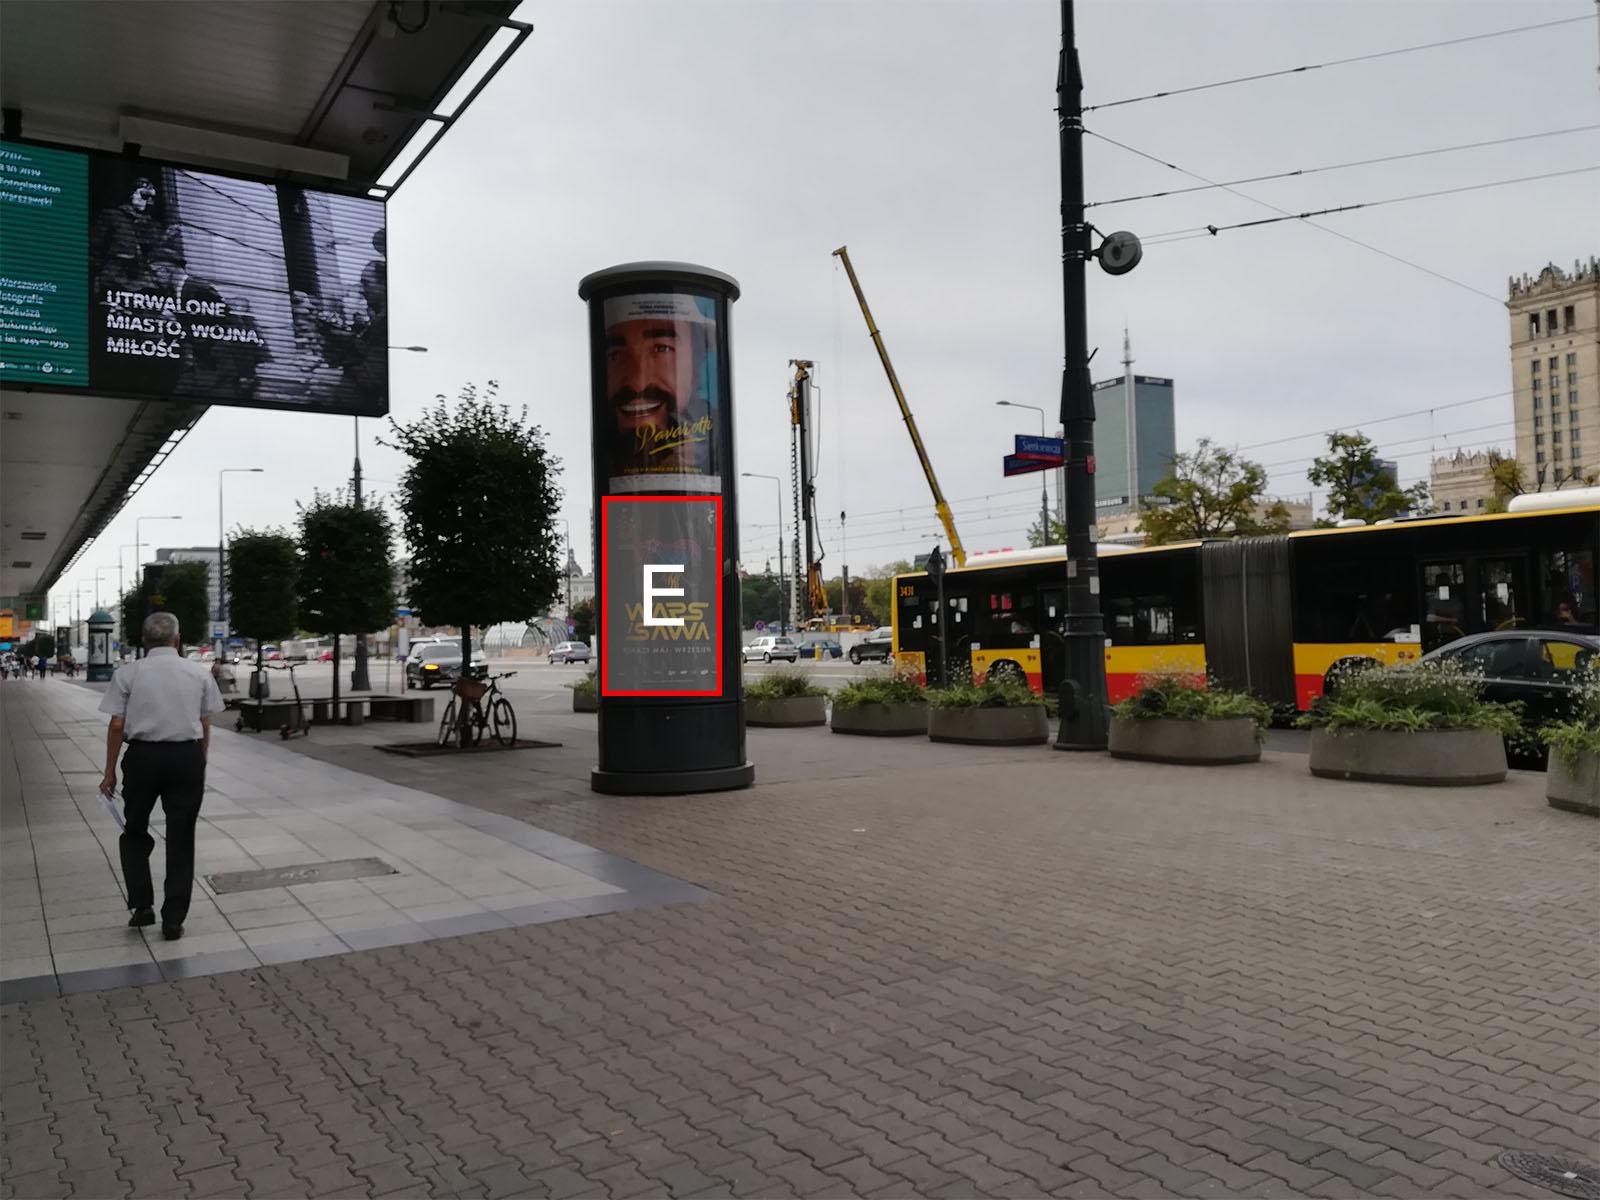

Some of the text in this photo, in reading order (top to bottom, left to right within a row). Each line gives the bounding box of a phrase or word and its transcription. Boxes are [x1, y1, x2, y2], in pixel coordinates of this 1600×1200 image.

[106, 290, 227, 317] UTRWALONE
[106, 313, 187, 340] MIASTO,
[106, 336, 181, 360] MIŁOŚĆ
[636, 416, 713, 450] Pavarotti
